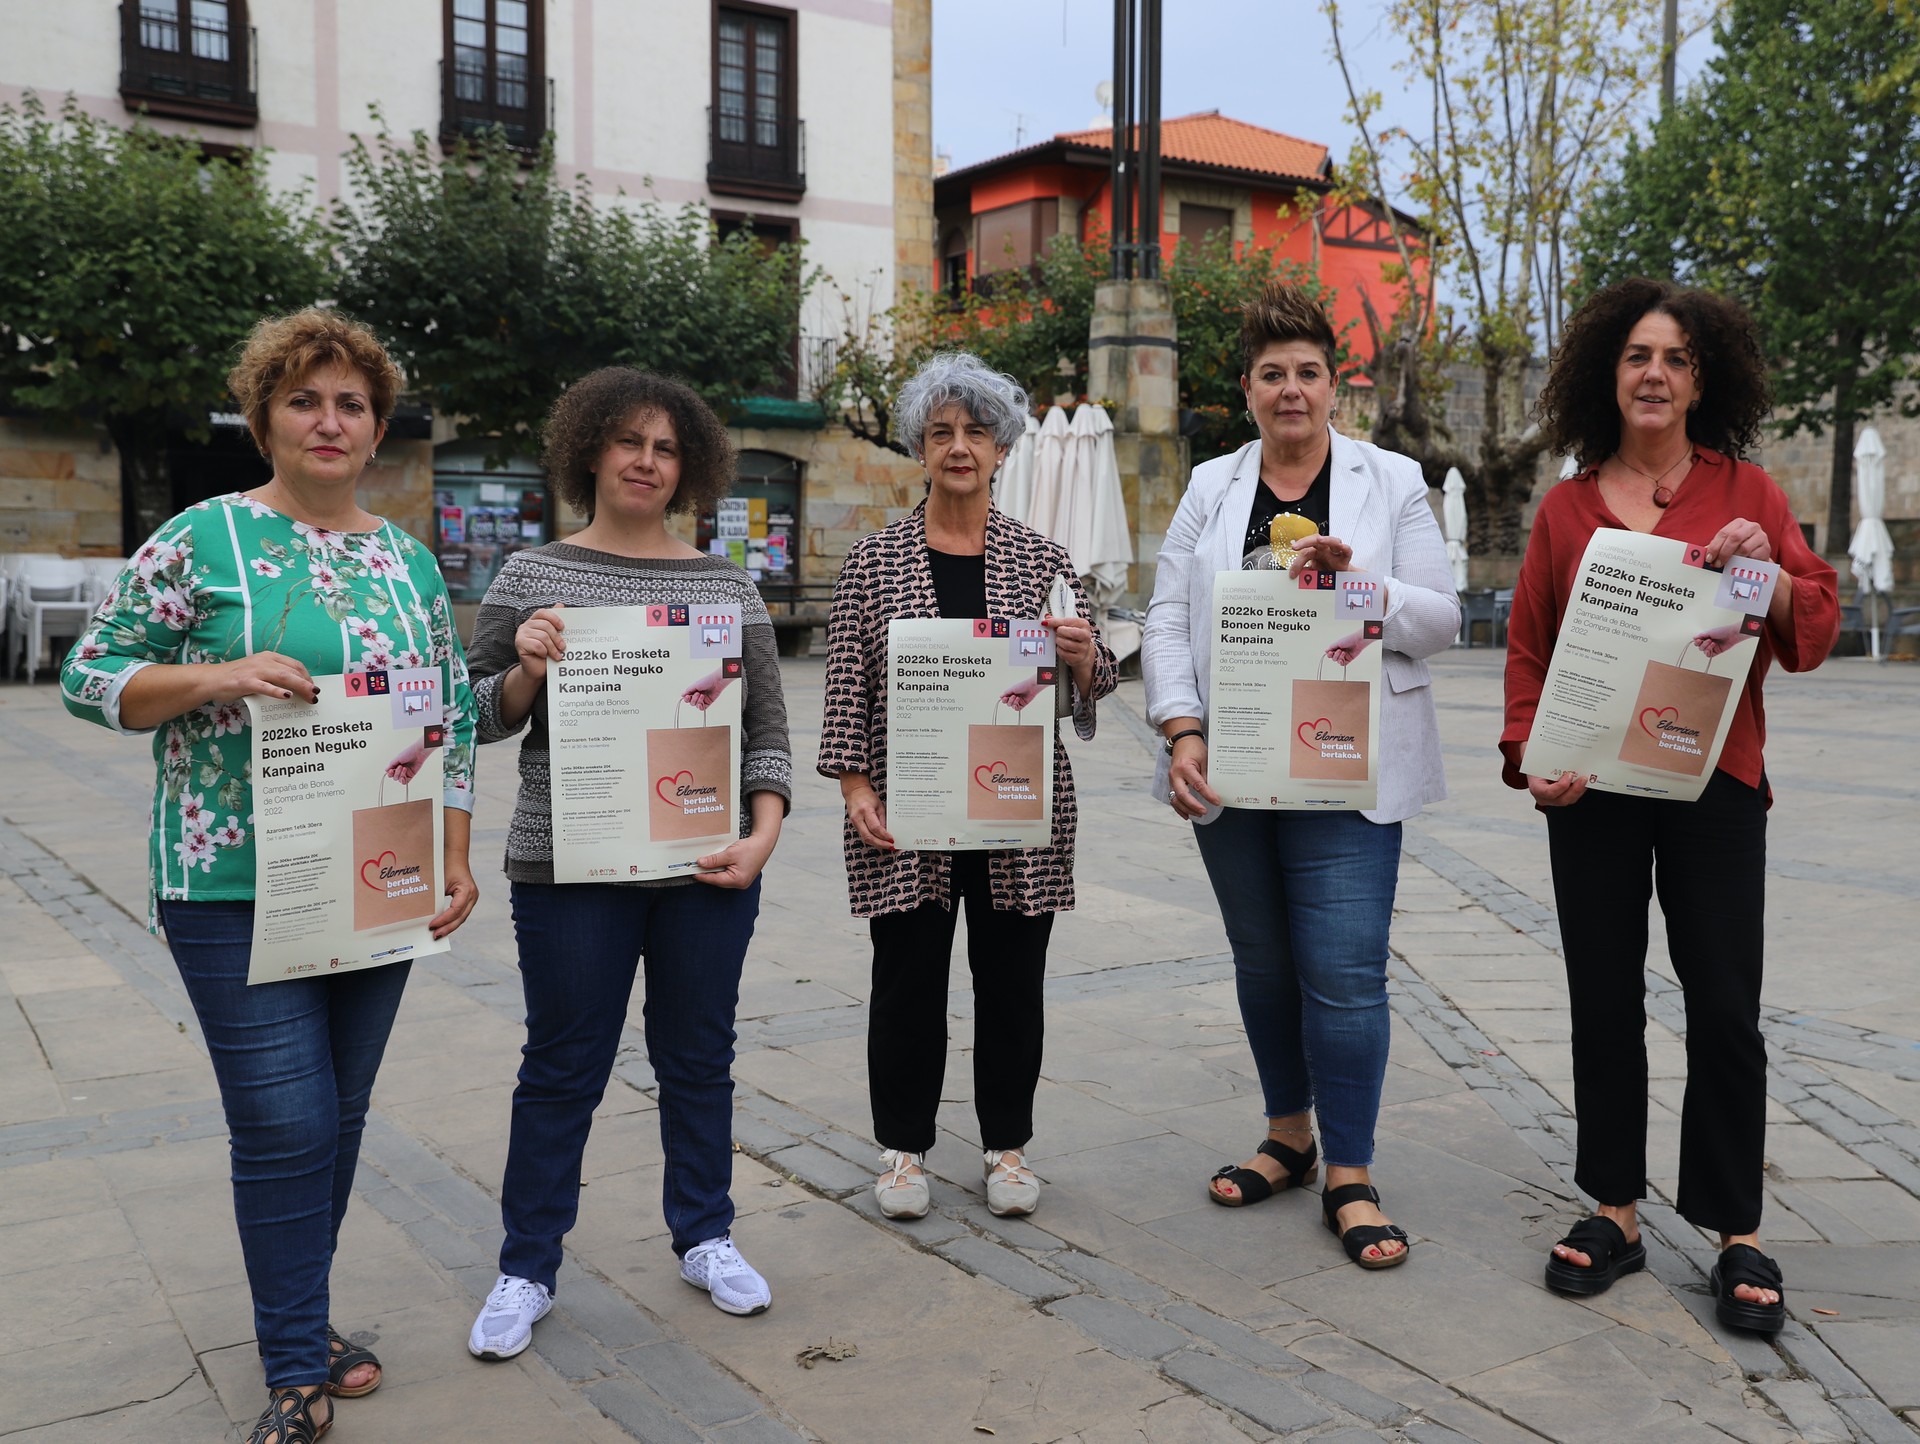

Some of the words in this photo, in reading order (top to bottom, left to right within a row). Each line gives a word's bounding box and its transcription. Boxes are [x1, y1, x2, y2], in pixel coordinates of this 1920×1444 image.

[1595, 551, 1627, 563] DENDARIK
[1629, 559, 1651, 568] DENDA
[1589, 562, 1636, 583] 2022ko
[1639, 576, 1696, 599] Erosketa
[1585, 576, 1632, 598] Bonoen
[1636, 590, 1684, 612] Neguko
[1580, 592, 1639, 617] Kanpaina
[1222, 607, 1263, 616] 2022ko
[1267, 608, 1317, 618] Erosketa
[1221, 620, 1264, 630] Bonoen
[1268, 621, 1311, 632] Neguko
[1576, 608, 1607, 624] Campaña
[1609, 615, 1618, 626] de
[1620, 618, 1641, 632] Bonos
[1571, 626, 1588, 637] 2022
[1573, 617, 1582, 626] de
[1583, 620, 1610, 636] Compra
[1612, 628, 1620, 637] de
[1622, 630, 1648, 643] Invierno
[1221, 634, 1274, 646] Kanpaina
[1220, 649, 1249, 658] Campaña
[1566, 643, 1590, 652] Azaroaren
[560, 650, 607, 661] 2022ko
[612, 649, 670, 659] Erosketa
[897, 655, 938, 665] 2022ko
[942, 655, 992, 665] Erosketa
[1229, 658, 1255, 666] Compra
[559, 666, 609, 676] Bonoen
[614, 664, 663, 677] Neguko
[897, 668, 940, 678] Bonoen
[944, 669, 986, 679] Neguko
[559, 681, 622, 694] Kanpaina
[897, 682, 950, 692] Kanpaina
[559, 700, 593, 709] Campaña
[896, 696, 925, 705] Campaña
[261, 703, 297, 712] ELORRIXON
[570, 709, 600, 718] Compra
[906, 705, 930, 713] Compra
[261, 712, 293, 722] DENDARIK
[294, 709, 319, 718] DENDA
[262, 726, 307, 742] 2022ko
[312, 720, 373, 736] Erosketa
[1657, 720, 1700, 737] Elorrixon
[1315, 731, 1355, 742] Elorrixon
[1661, 731, 1697, 746] bertatik
[262, 743, 310, 759] Bonoen
[315, 739, 367, 754] Neguko
[1658, 740, 1702, 756] bertakoak
[1321, 751, 1362, 759] bertakoak
[262, 761, 324, 778] Kanpaina
[991, 773, 1030, 784] Elorrixon
[263, 783, 297, 795] Campaña
[299, 781, 308, 790] de
[310, 779, 334, 788] Bonos
[677, 785, 717, 797] Elorrixon
[264, 797, 273, 805] de
[274, 794, 304, 805] Compra
[305, 792, 315, 800] de
[317, 788, 345, 798] Invierno
[684, 796, 717, 806] bertatik
[264, 807, 283, 816] 2022
[684, 805, 724, 815] bertakoak
[380, 864, 420, 879] Elorrixon
[387, 875, 420, 888] bertatik
[387, 884, 428, 898] bertakoak
